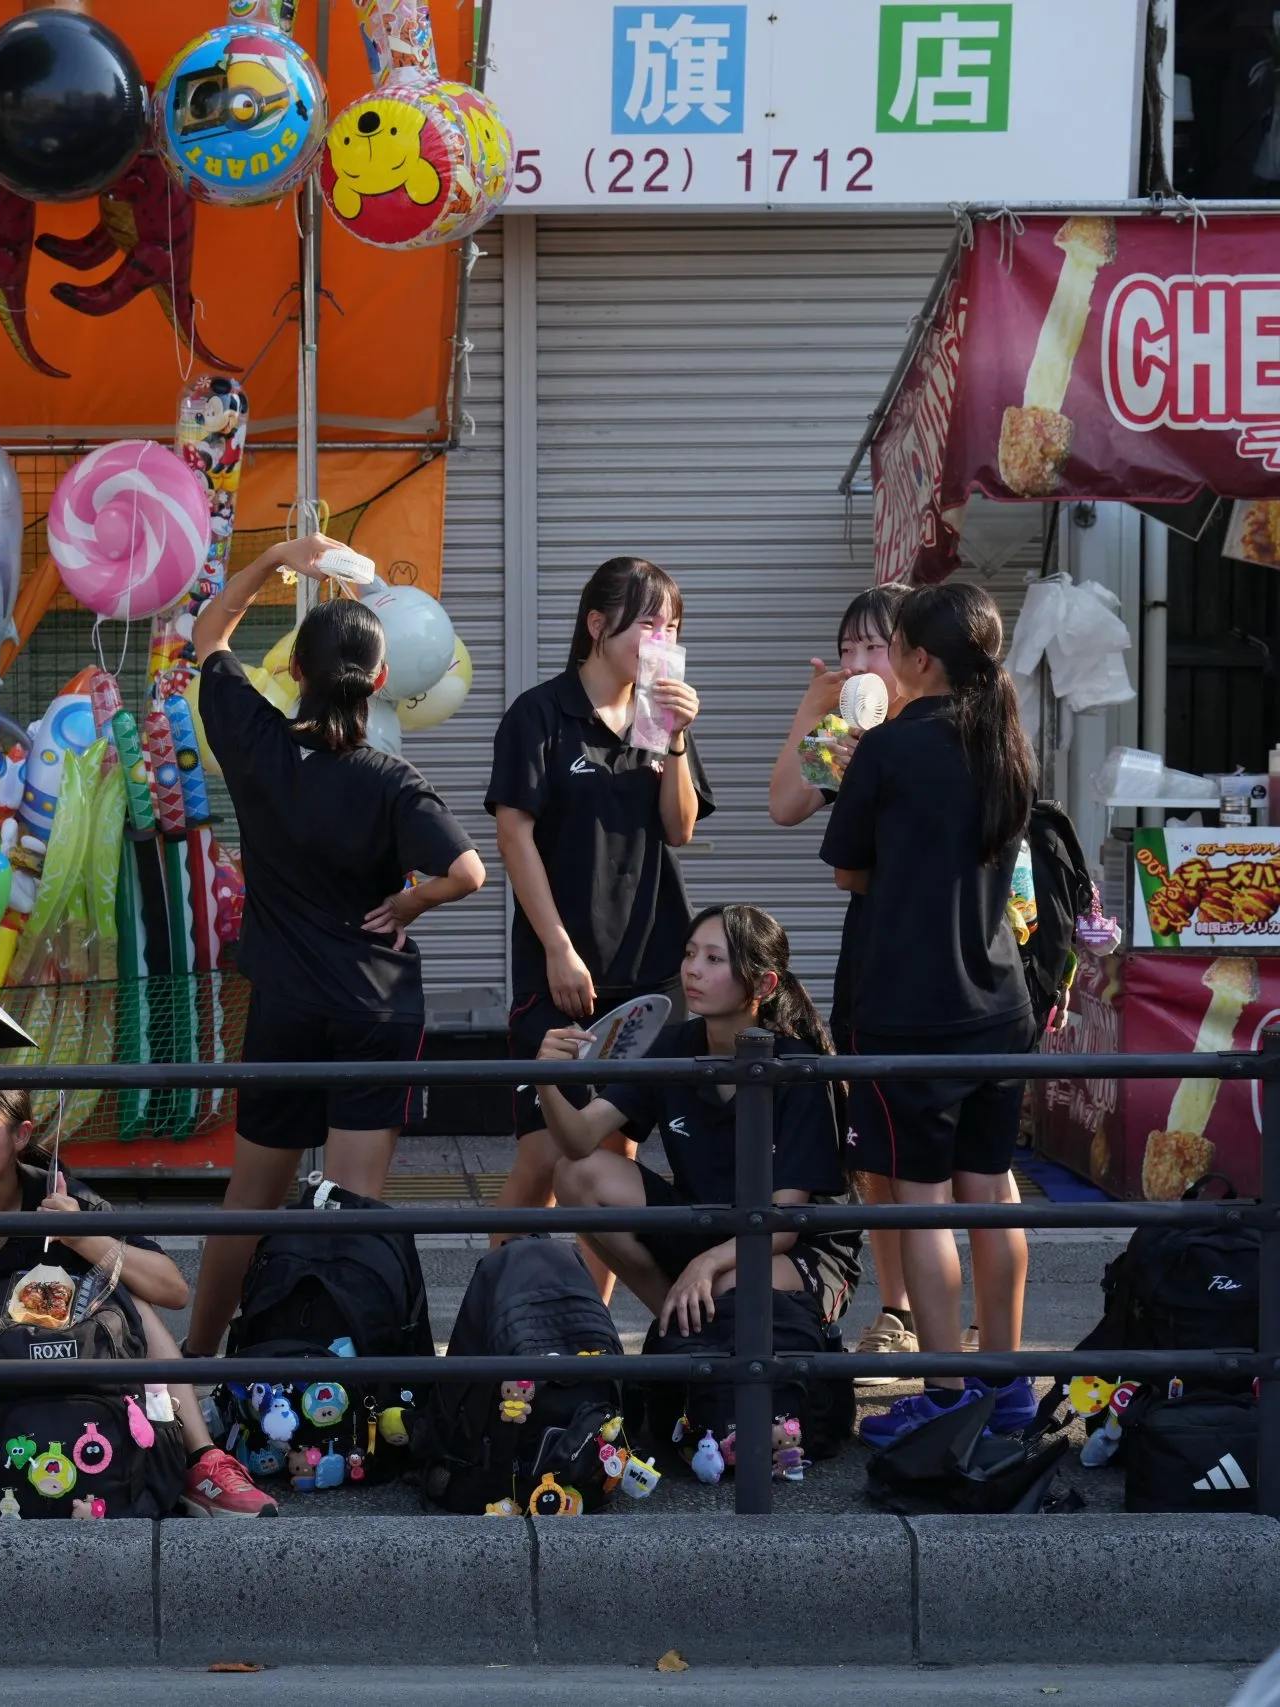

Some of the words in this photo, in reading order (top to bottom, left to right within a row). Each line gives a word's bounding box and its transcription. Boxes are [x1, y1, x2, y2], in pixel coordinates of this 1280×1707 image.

[623, 12, 732, 126] 旗
[889, 12, 1000, 125] 店
[185, 127, 298, 180] STUART
[736, 147, 874, 193] 1712
[1106, 276, 1280, 428] CHE
[1180, 861, 1280, 889] チーズハ
[33, 1343, 72, 1359] ROXY
[629, 1467, 649, 1486] win
